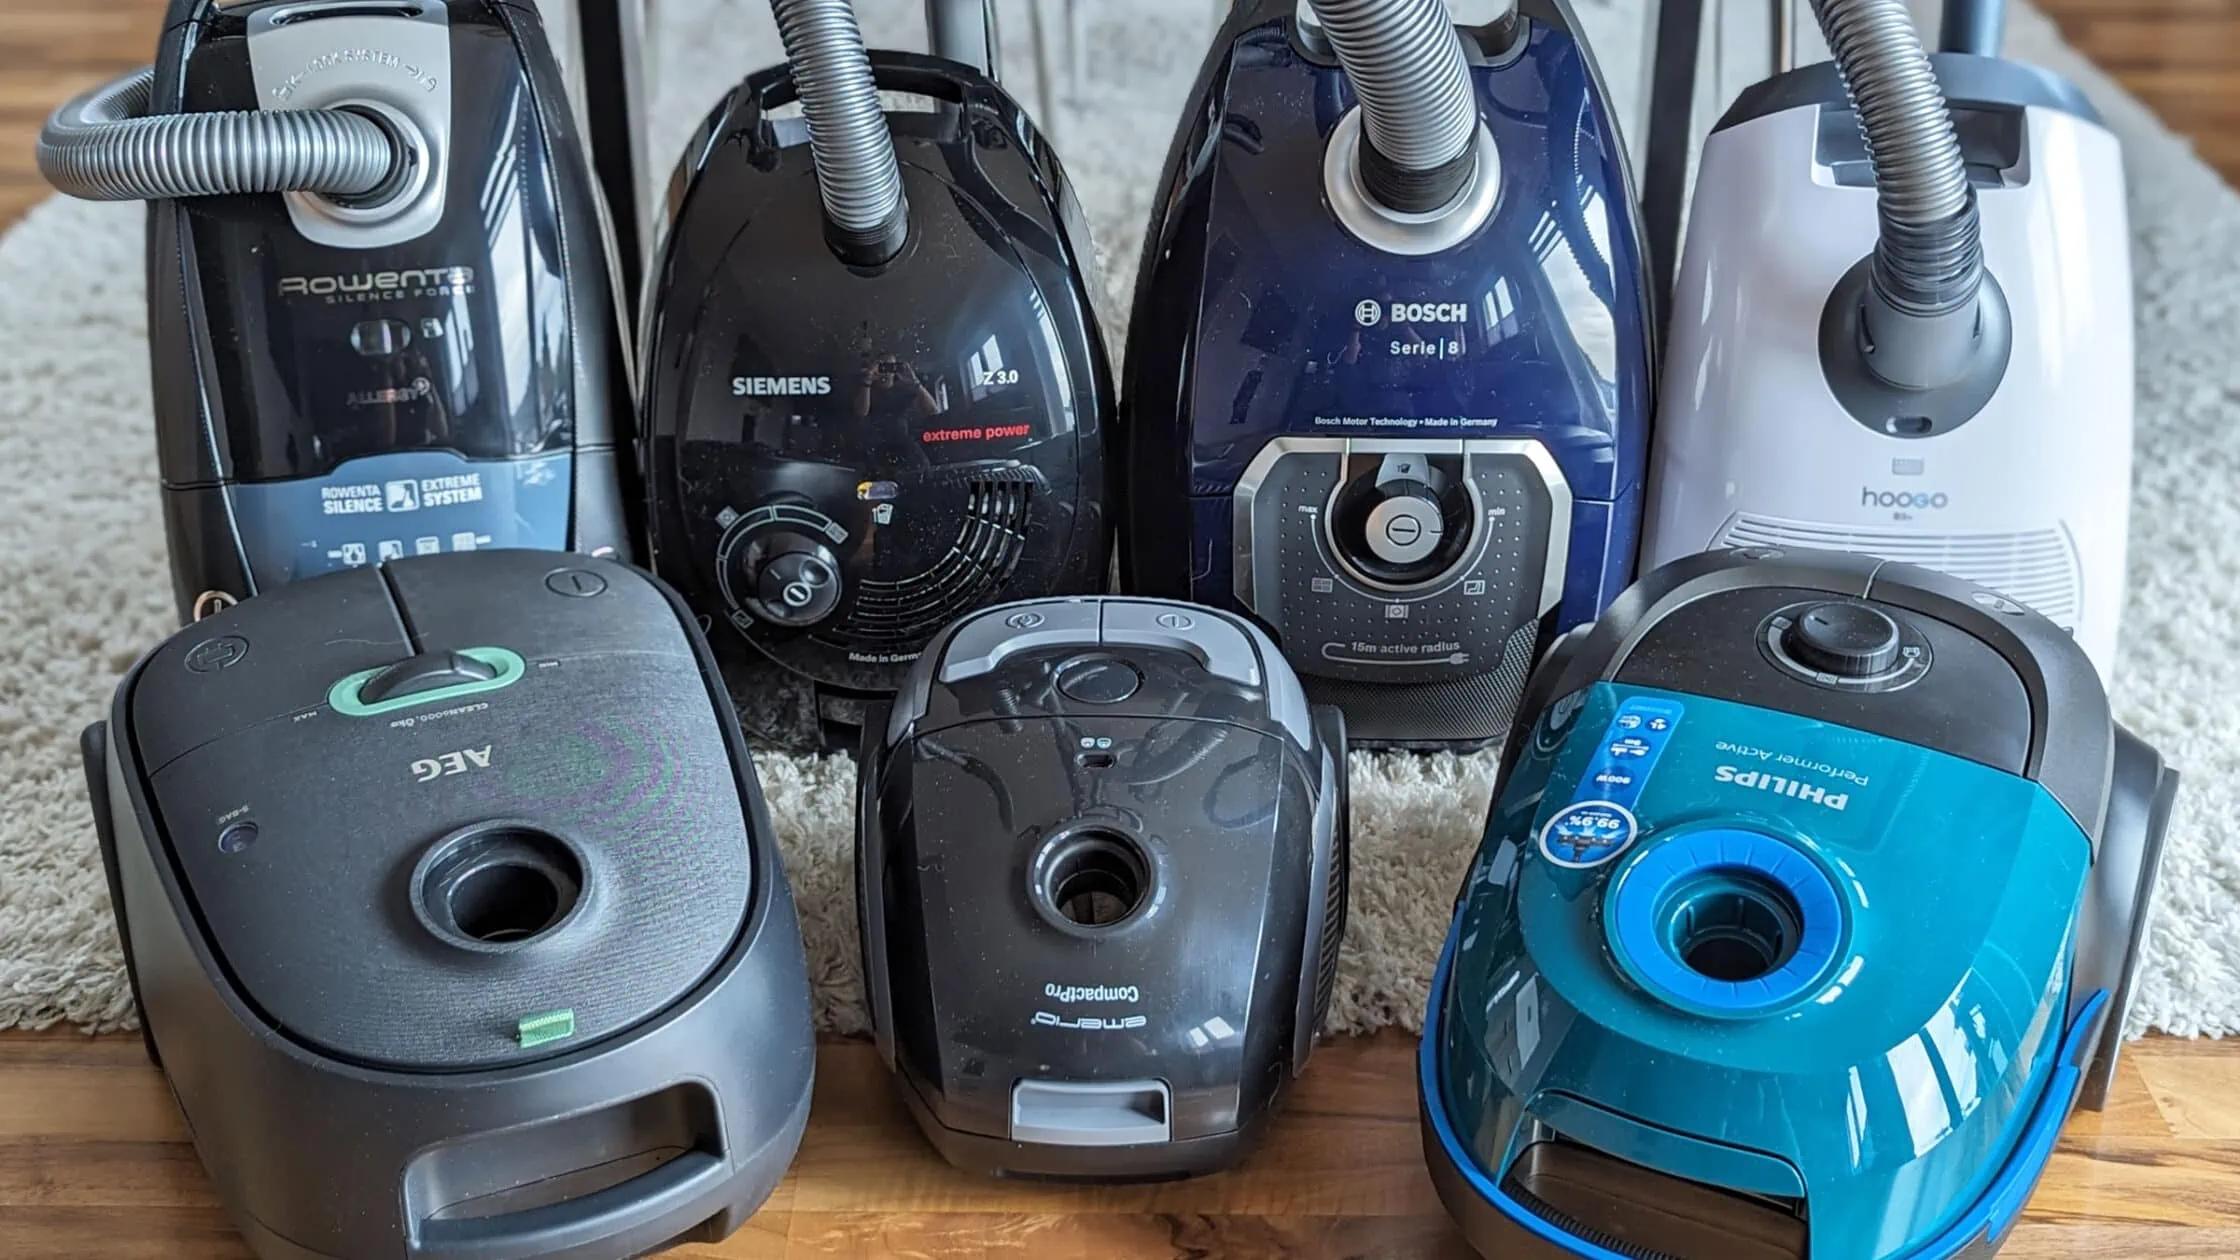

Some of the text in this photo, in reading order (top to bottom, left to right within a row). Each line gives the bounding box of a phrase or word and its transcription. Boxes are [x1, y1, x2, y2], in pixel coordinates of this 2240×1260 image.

[325, 291, 405, 304] SILENCE
[1391, 303, 1467, 322] BOSCH
[732, 376, 831, 396] SIEMENS
[983, 370, 1019, 386] Z 3.0
[1315, 416, 1498, 428] Bosch Motor Technology Made in Germany
[922, 424, 1030, 442] extreme power
[421, 473, 480, 492] EXTREME
[321, 485, 381, 499] ROWENTA
[423, 487, 483, 507] SYSTEM
[324, 498, 383, 514] SILENCE
[1298, 505, 1318, 514] max
[1488, 507, 1506, 516] min
[1351, 641, 1460, 654] 15m active radius
[848, 652, 922, 663] Made in Germ
[410, 744, 492, 782] AEG
[1715, 741, 1869, 786] Performer Active
[1714, 765, 1849, 811] PHILIPS
[1045, 983, 1139, 1002] CompactPro
